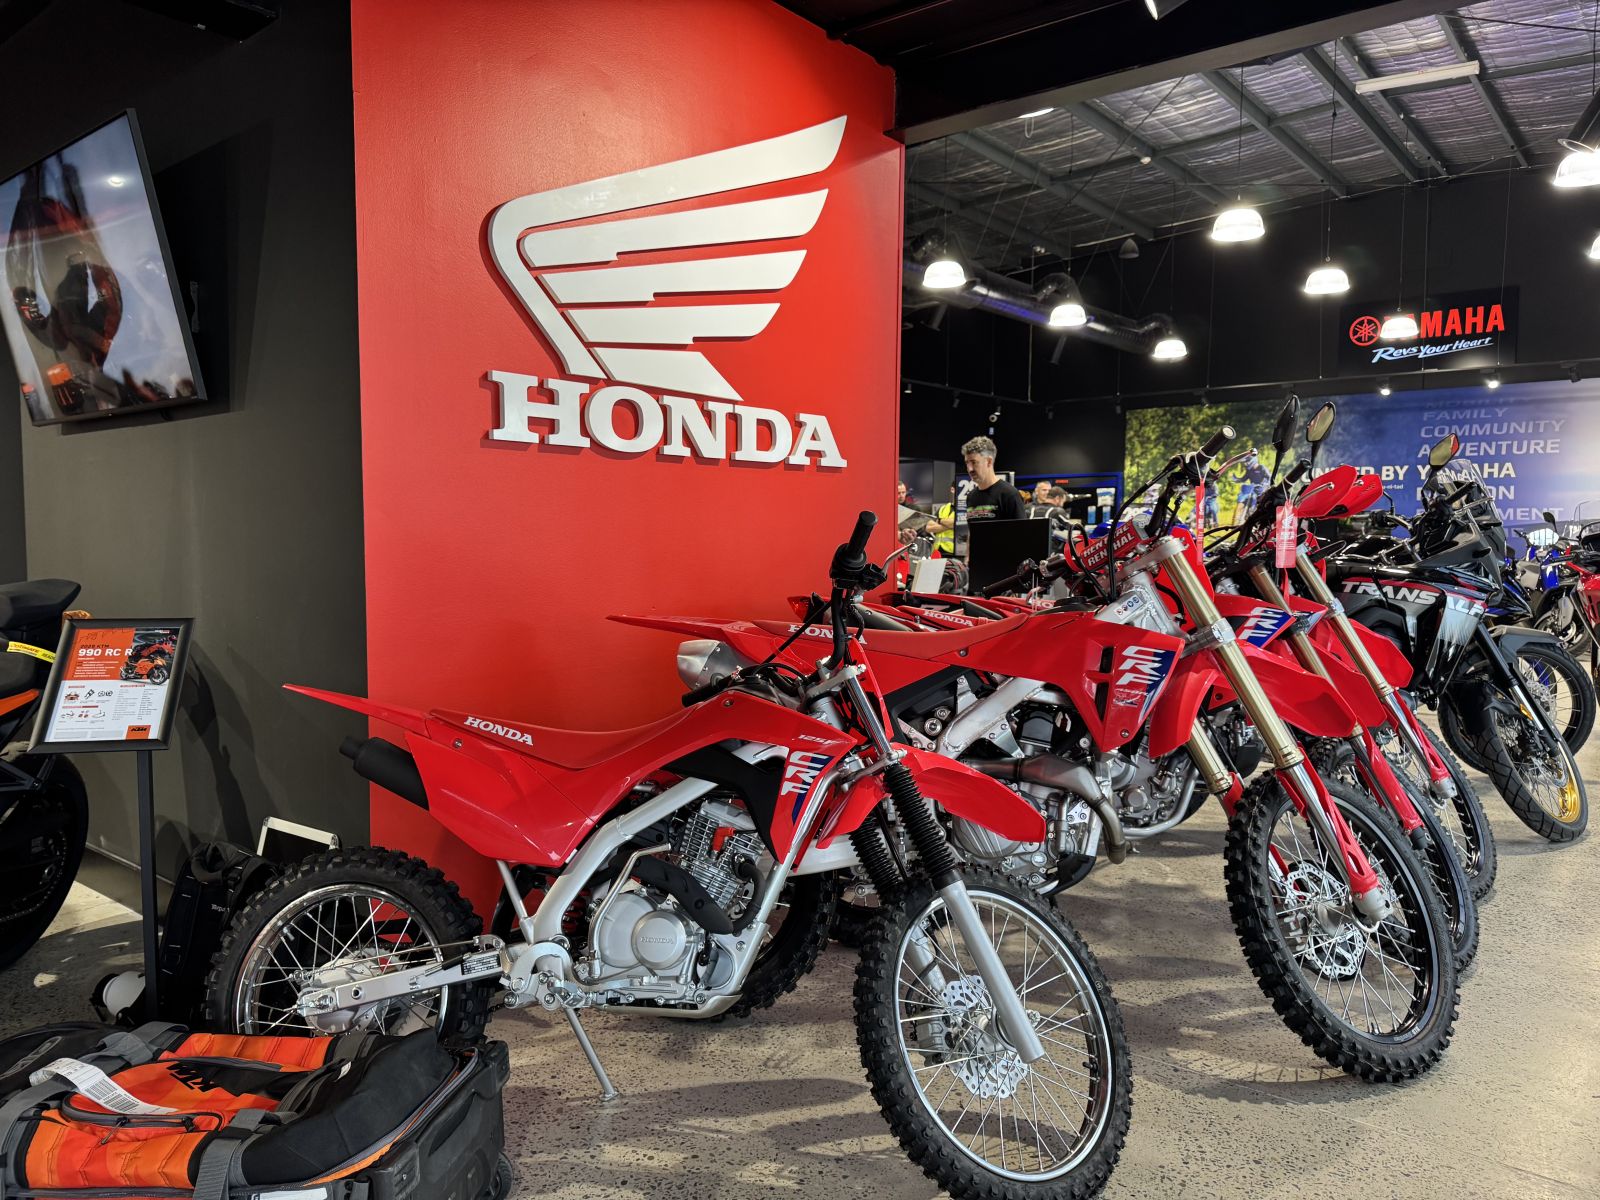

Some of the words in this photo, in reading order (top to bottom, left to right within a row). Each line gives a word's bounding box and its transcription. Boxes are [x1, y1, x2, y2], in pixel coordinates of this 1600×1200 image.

[1383, 303, 1505, 341] MAHA
[1371, 346, 1420, 363] Revs
[1418, 343, 1453, 358] Your
[1452, 337, 1492, 351] Heart
[488, 369, 848, 468] HONDA
[1423, 407, 1509, 421] FAMILY
[1420, 420, 1566, 438] COMMUNITY
[1417, 439, 1561, 458] AVENTURE
[1381, 465, 1409, 481] BY
[1088, 533, 1134, 567] RENHAL
[1341, 581, 1441, 605] TRANS
[923, 610, 974, 627] HONDA
[788, 623, 867, 645] HONA
[78, 648, 102, 657] 990
[105, 648, 122, 656] RC
[124, 648, 133, 656] R
[464, 716, 534, 746] HONDA
